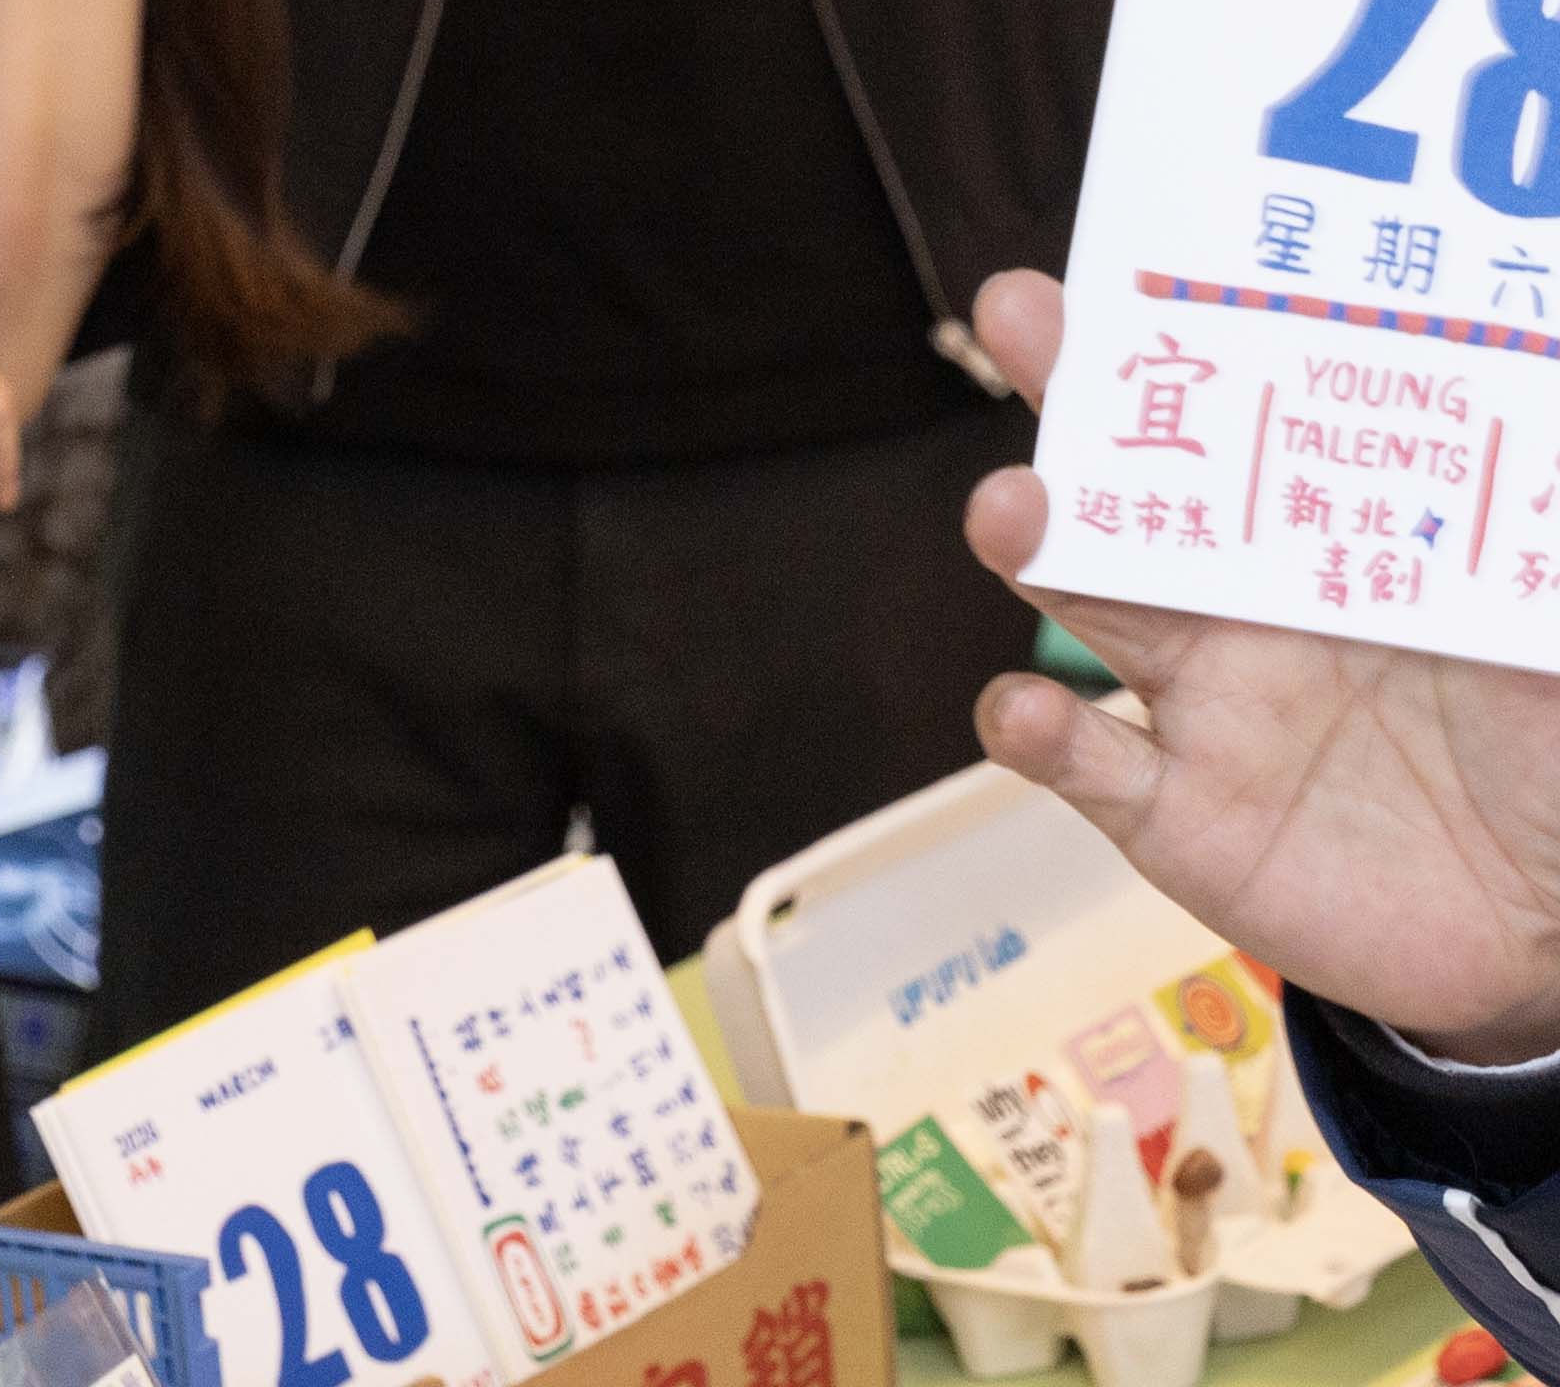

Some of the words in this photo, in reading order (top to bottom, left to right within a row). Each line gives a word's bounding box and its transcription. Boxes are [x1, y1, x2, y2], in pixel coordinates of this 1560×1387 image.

[1255, 194, 1550, 318] 星期六
[1113, 332, 1219, 458] 宜
[1303, 355, 1469, 424] YOUNG
[1281, 415, 1469, 484] TALENTS
[1074, 484, 1220, 550] 逛市集
[1281, 476, 1398, 538] 新北
[1313, 540, 1424, 610] 青創
[218, 1161, 430, 1387] 28
